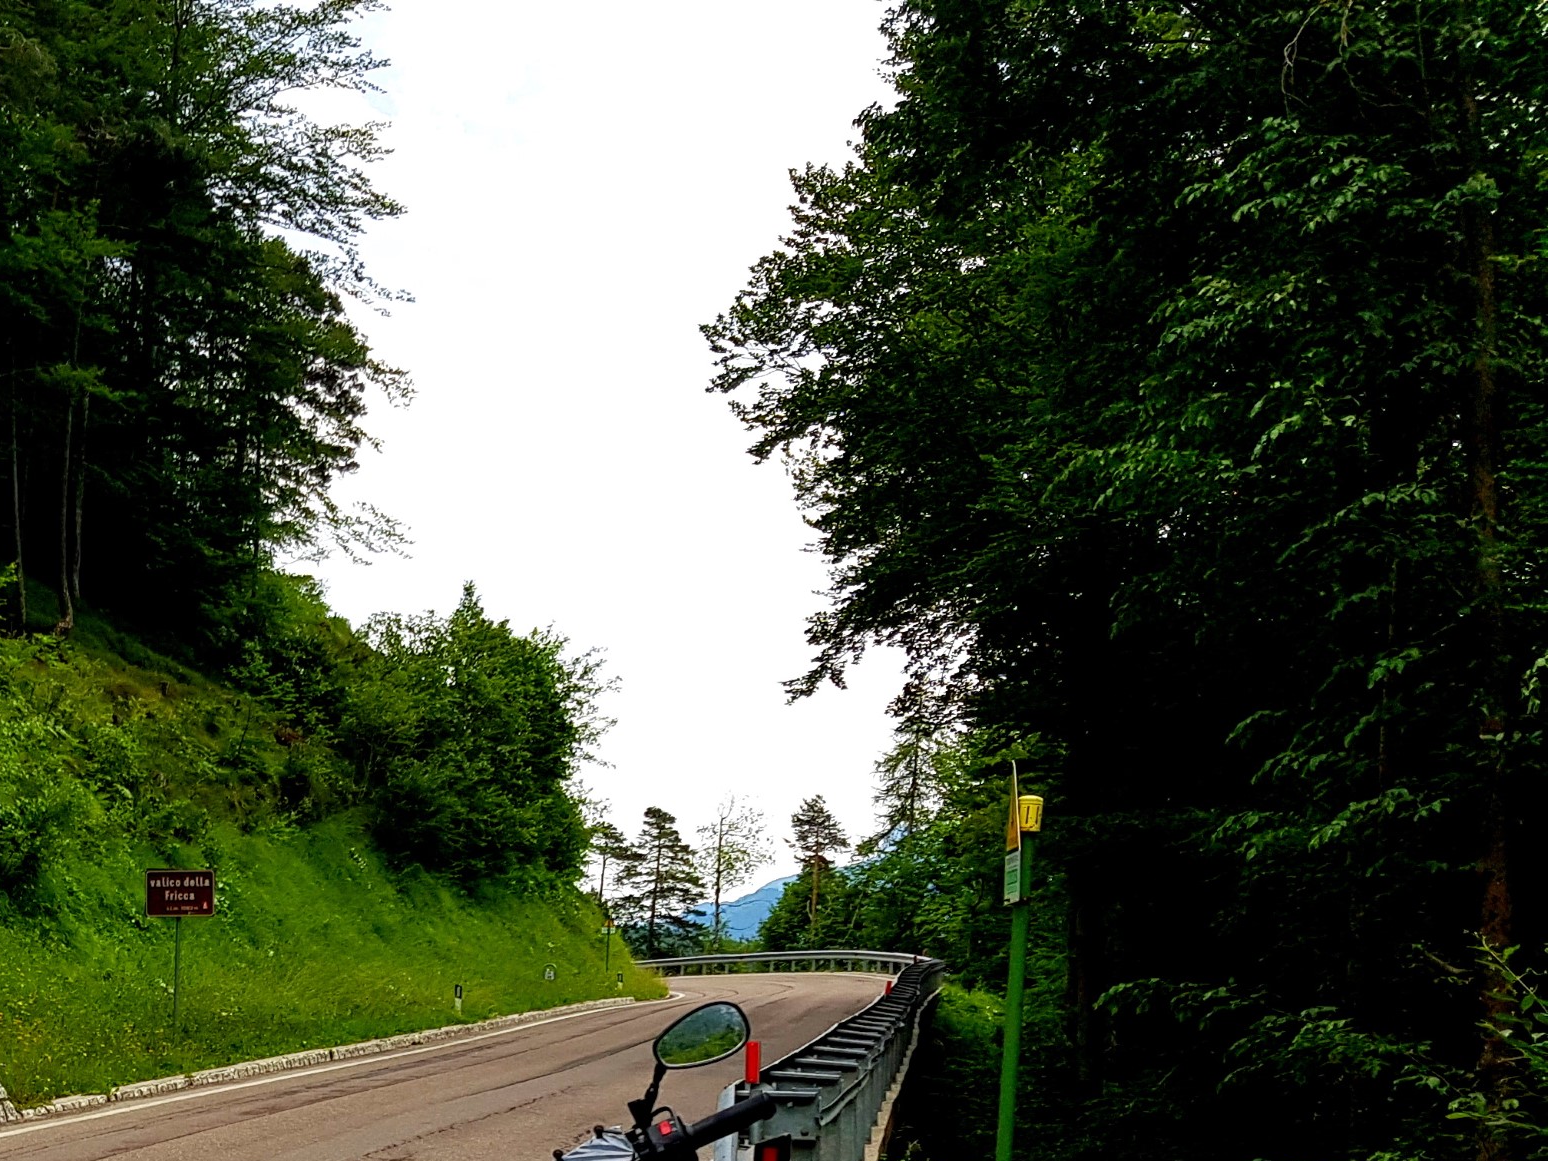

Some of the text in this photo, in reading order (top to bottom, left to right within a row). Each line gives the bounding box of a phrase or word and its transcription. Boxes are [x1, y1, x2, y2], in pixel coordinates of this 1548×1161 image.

[150, 876, 210, 888] valico della
[164, 890, 195, 901] Fricca
